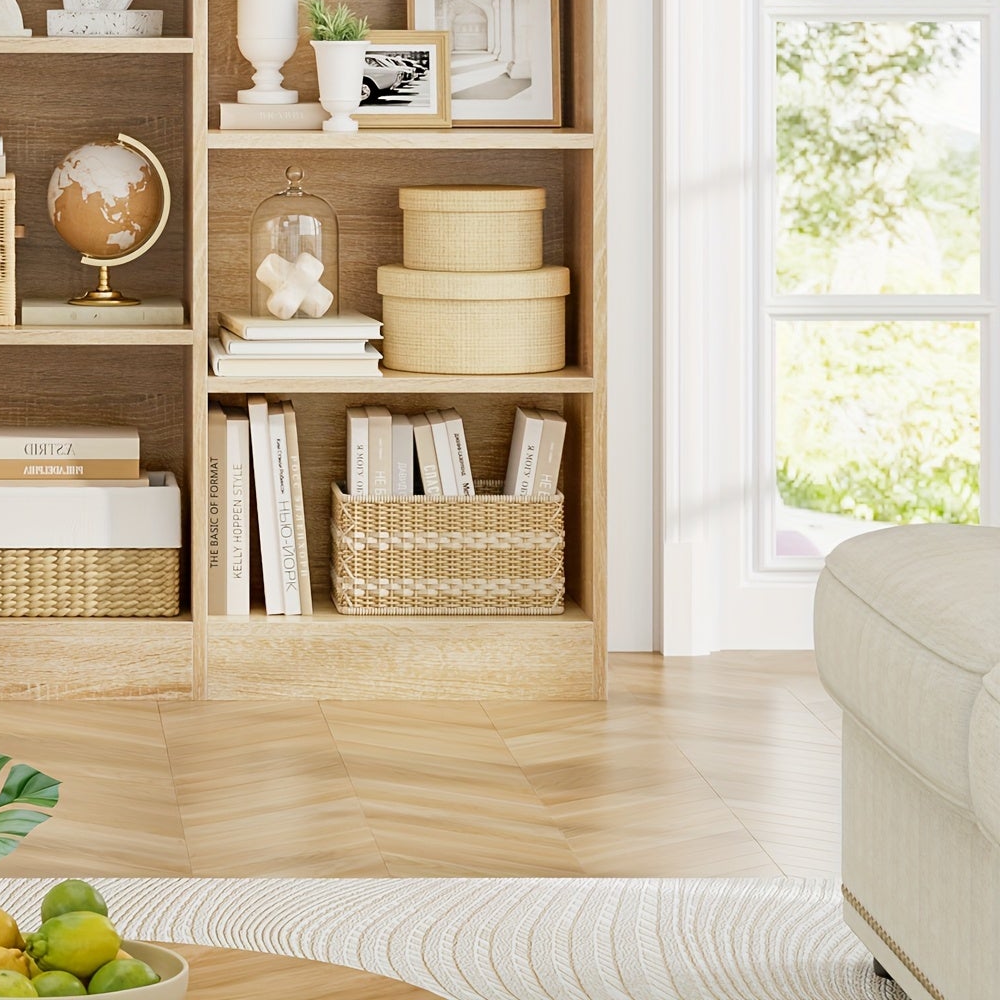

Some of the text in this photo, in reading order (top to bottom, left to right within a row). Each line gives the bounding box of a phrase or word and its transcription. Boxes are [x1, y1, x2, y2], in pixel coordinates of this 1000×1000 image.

[210, 457, 218, 568] THE BASIC OF FORMAT
[233, 463, 242, 579] KELLY HOPPEN STYLE
[278, 500, 297, 591] НЬЮ-ЙОРК
